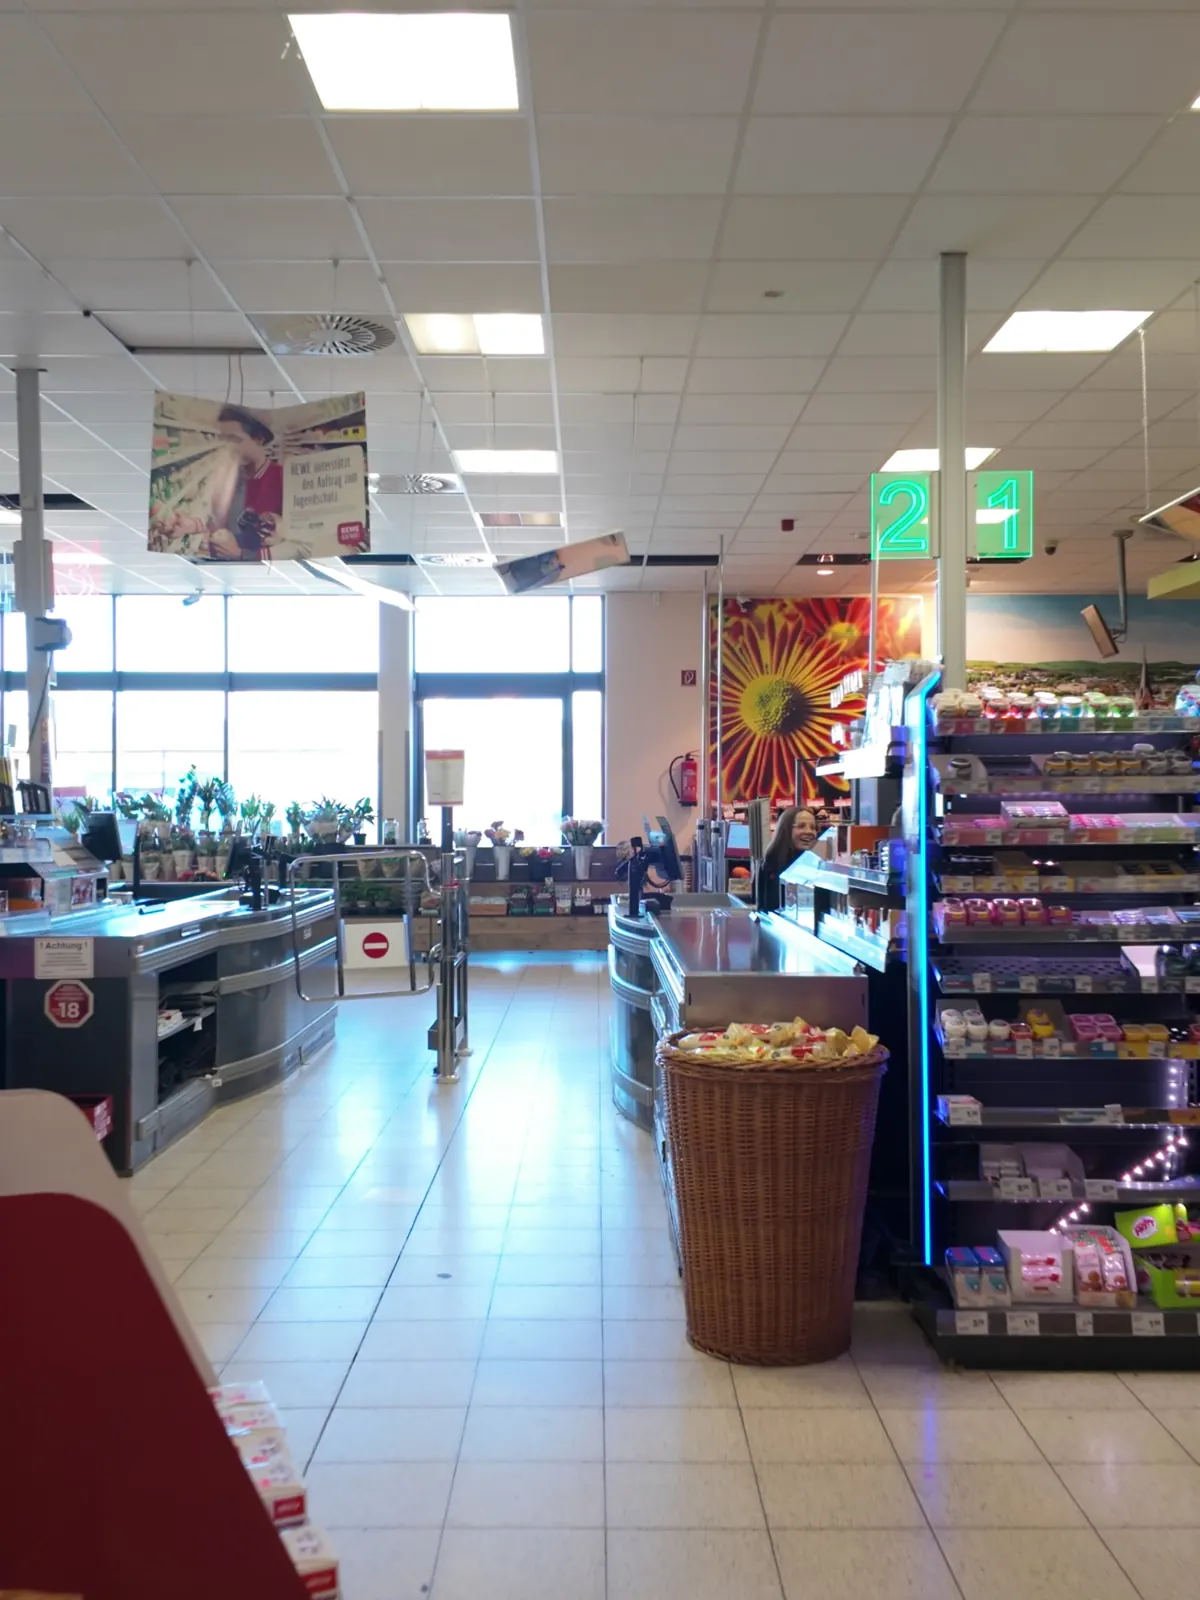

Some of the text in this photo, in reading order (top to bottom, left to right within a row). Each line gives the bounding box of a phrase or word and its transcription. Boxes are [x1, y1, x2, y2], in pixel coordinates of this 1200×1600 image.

[317, 474, 342, 488] Auftrag
[879, 479, 926, 551] 2
[987, 479, 1017, 550] 1
[45, 941, 83, 951] Achtung
[58, 1002, 80, 1018] 18
